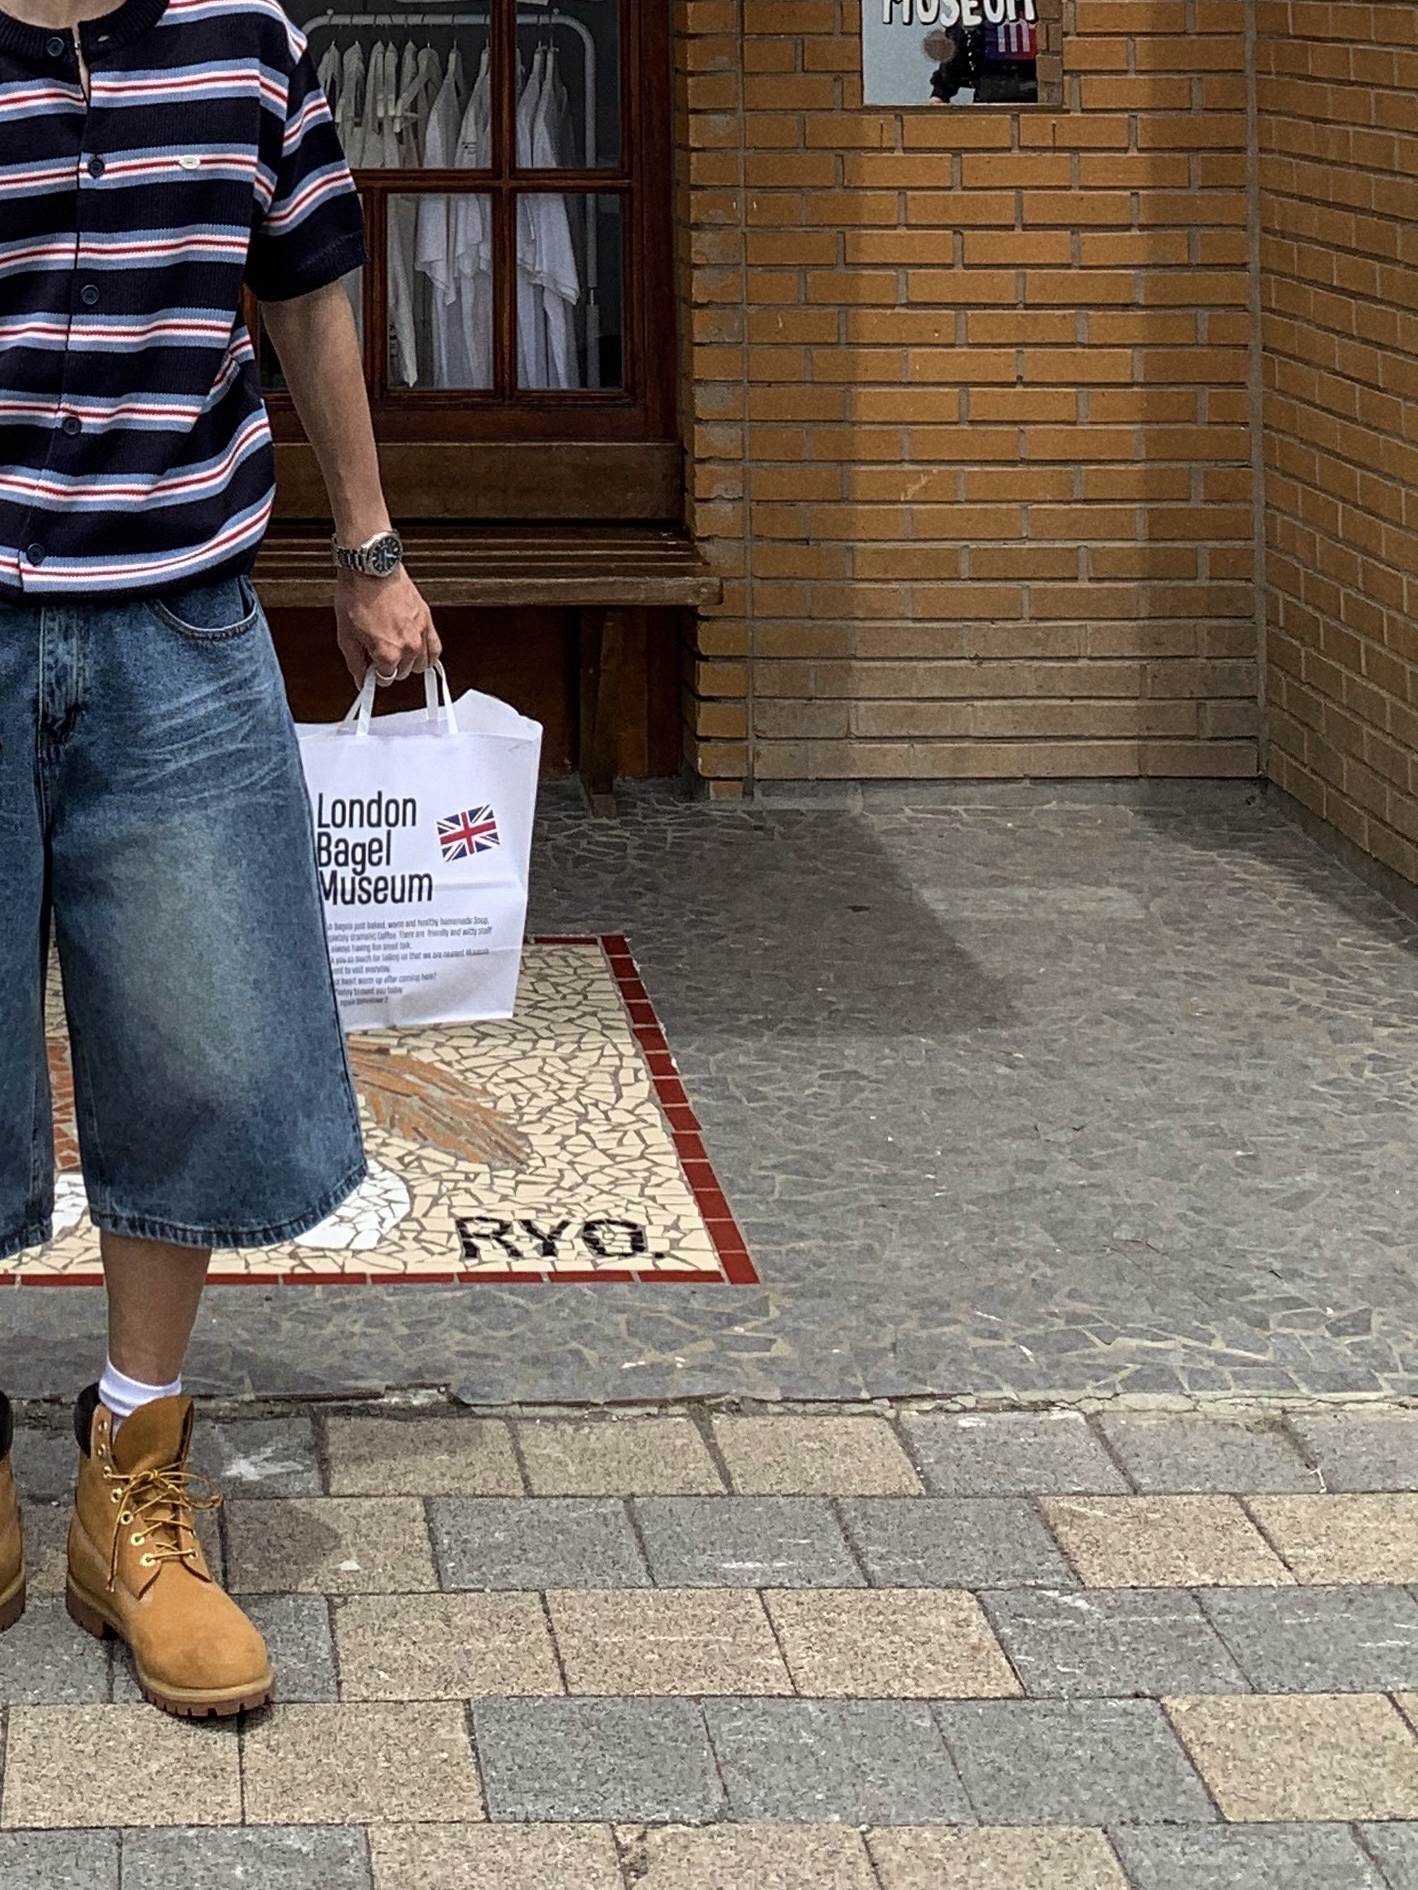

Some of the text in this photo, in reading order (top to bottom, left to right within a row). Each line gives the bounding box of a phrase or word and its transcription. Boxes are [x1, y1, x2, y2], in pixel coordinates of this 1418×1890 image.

[317, 790, 418, 829] London
[317, 830, 393, 876] Bagel
[318, 870, 434, 906] Museum
[456, 1216, 665, 1259] RYO.
